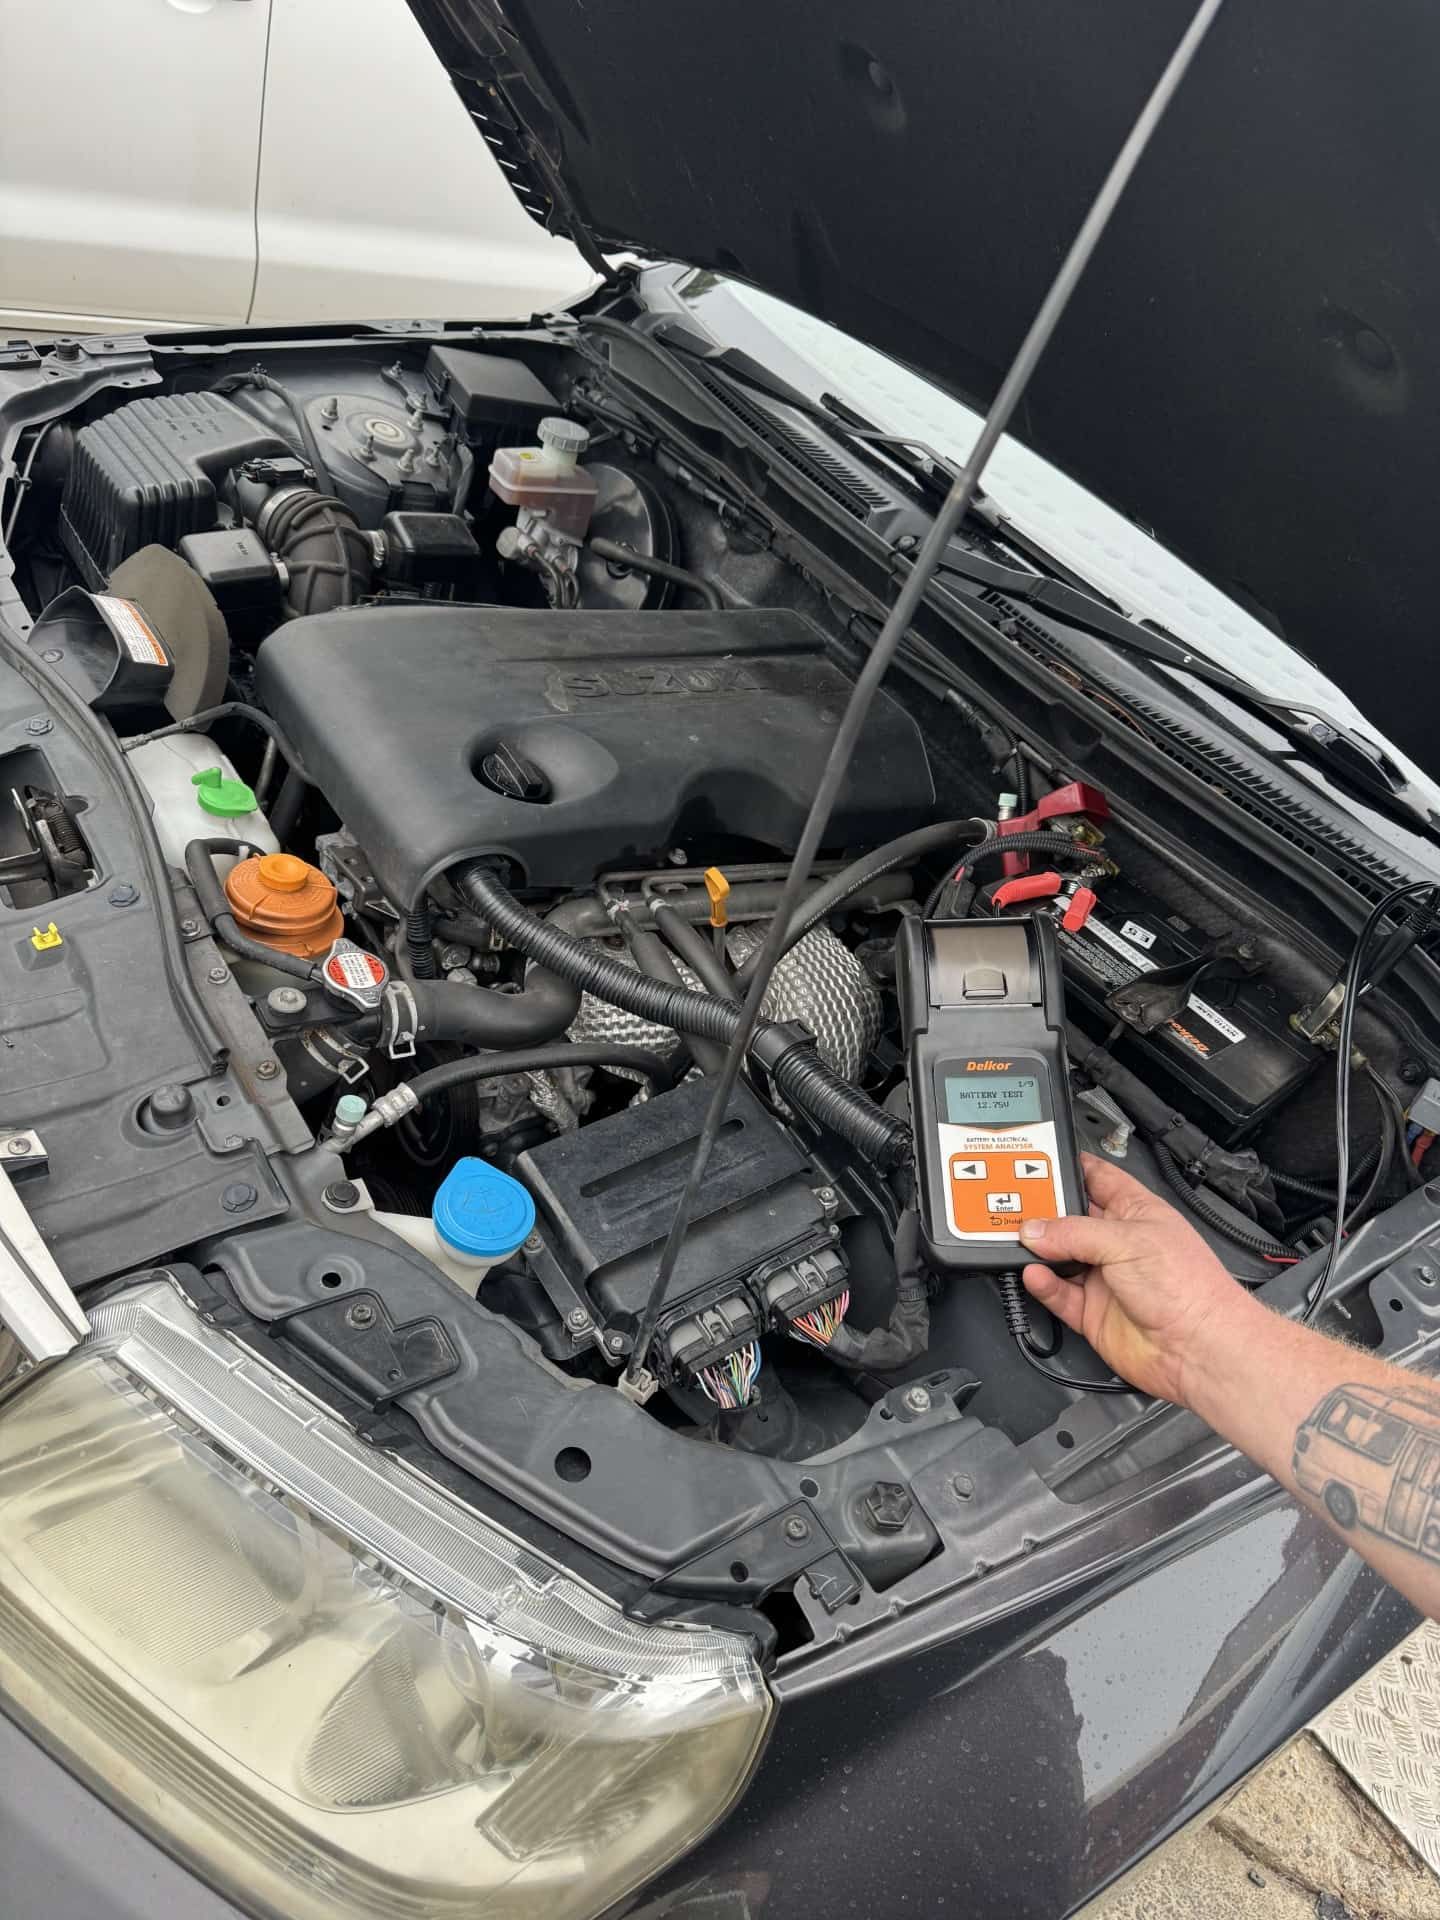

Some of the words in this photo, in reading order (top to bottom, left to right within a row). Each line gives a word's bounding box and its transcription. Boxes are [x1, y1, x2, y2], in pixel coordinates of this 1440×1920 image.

[966, 1060, 1014, 1072] Delkor
[960, 1091, 997, 1099] BATTERY
[1001, 1090, 1024, 1098] TEST
[977, 1101, 1009, 1109] 12.75V
[964, 1143, 993, 1151] SYSTEM
[995, 1142, 1033, 1150] ANALYSER
